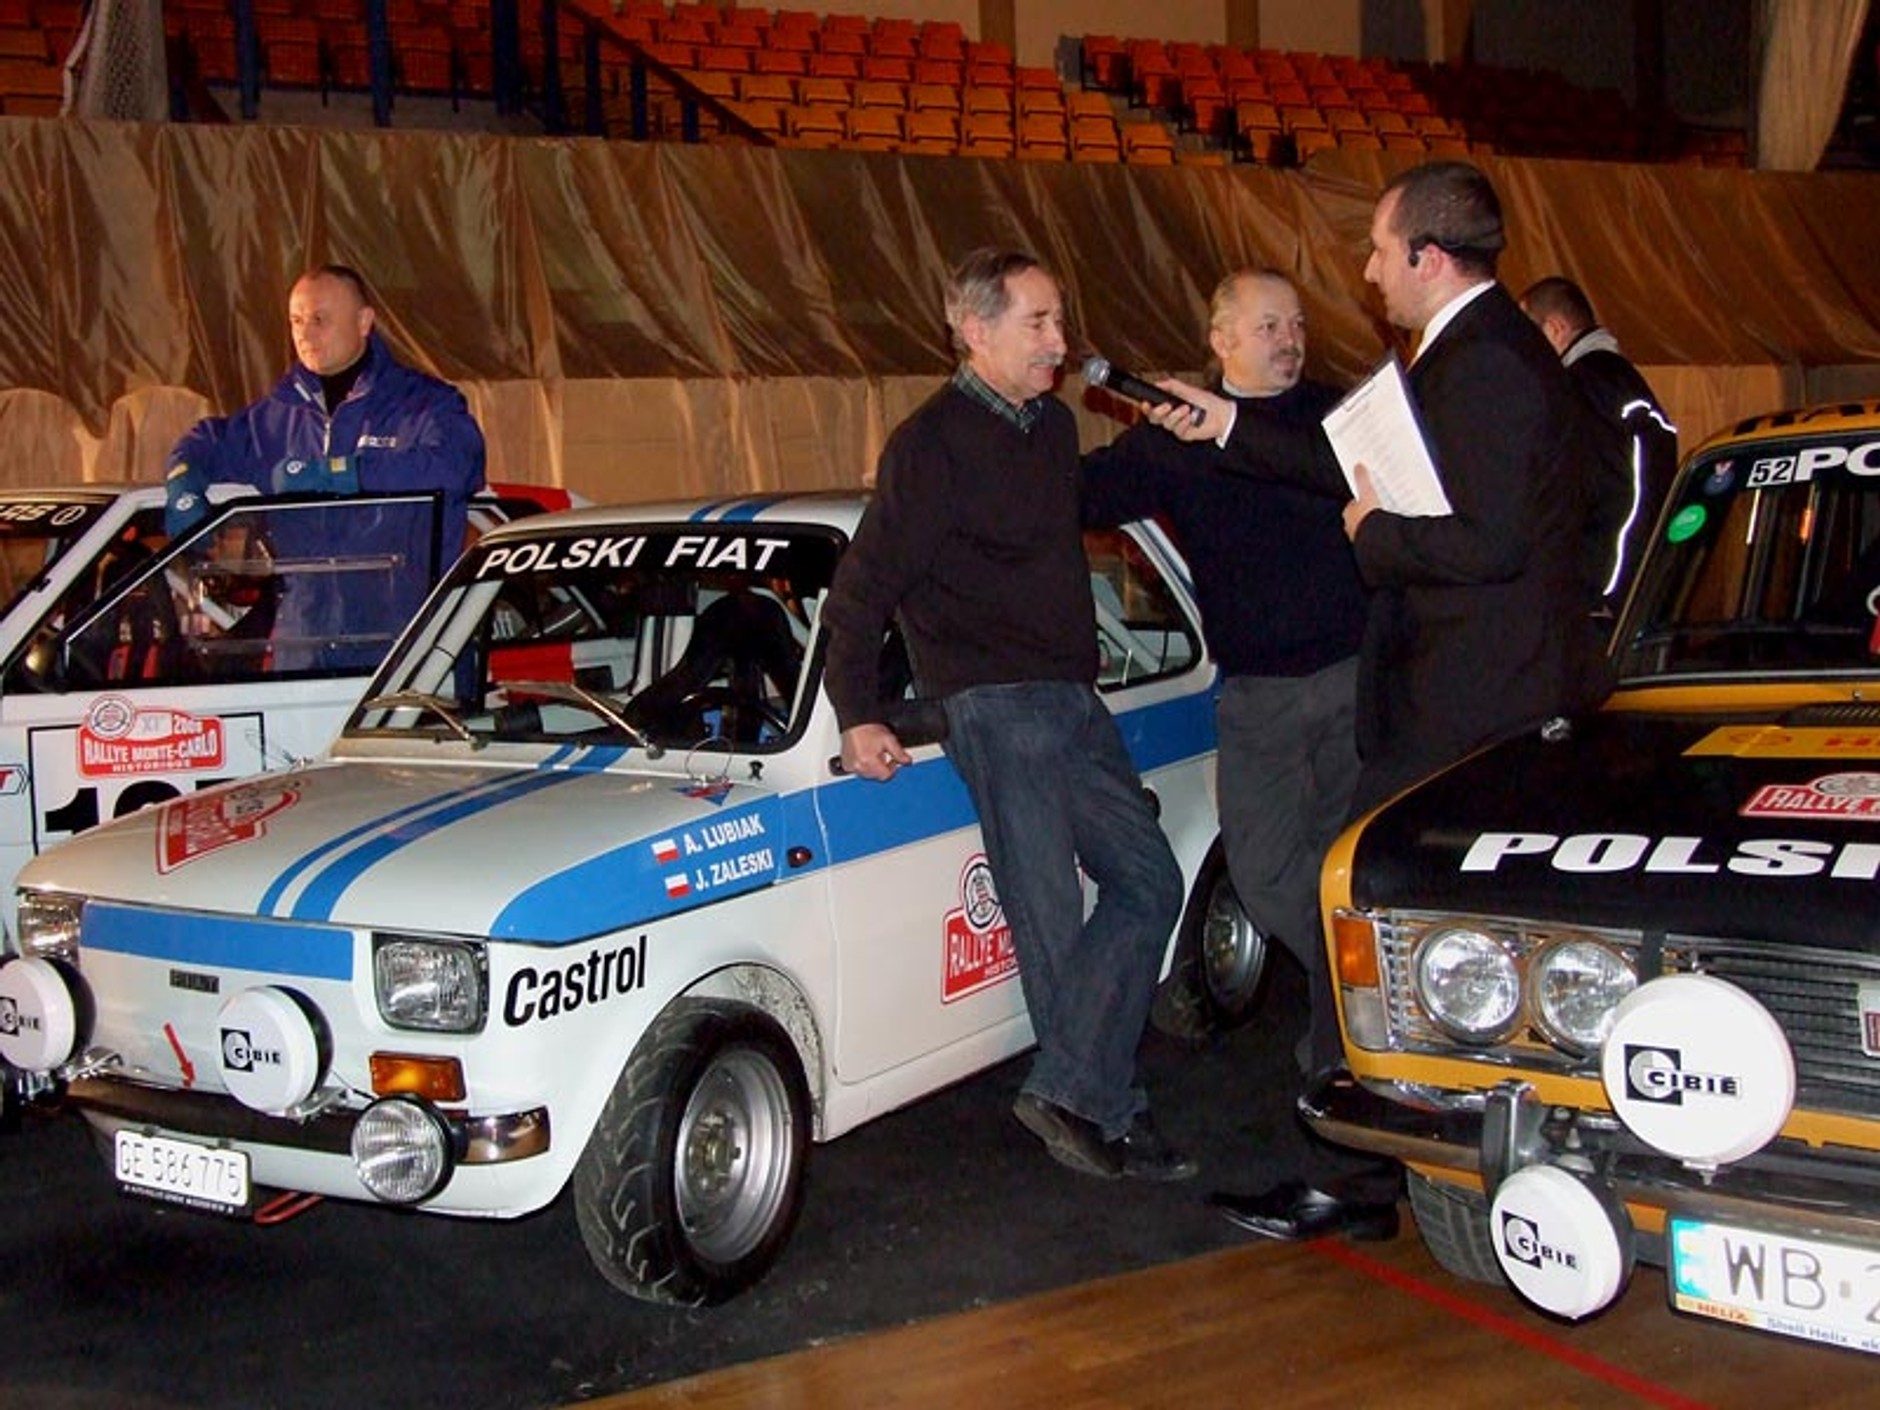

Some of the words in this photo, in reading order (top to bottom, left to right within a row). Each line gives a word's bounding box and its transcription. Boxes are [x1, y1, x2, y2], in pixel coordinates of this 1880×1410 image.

[1752, 461, 1792, 483] 52
[476, 537, 647, 579] POLSKI
[665, 536, 790, 571] FIAT
[84, 738, 128, 765] RALLYE
[131, 729, 218, 760] MONTE-CARLO
[684, 833, 703, 855] A.
[702, 813, 765, 850] LUBIAK
[695, 869, 709, 891] J.
[710, 848, 774, 886] ZALESKI
[949, 931, 994, 979] RALLYE
[504, 935, 648, 1027] Castrol
[1724, 1237, 1826, 1310] WB
[1767, 1316, 1807, 1338] Shell
[1809, 1325, 1848, 1343] Helix
